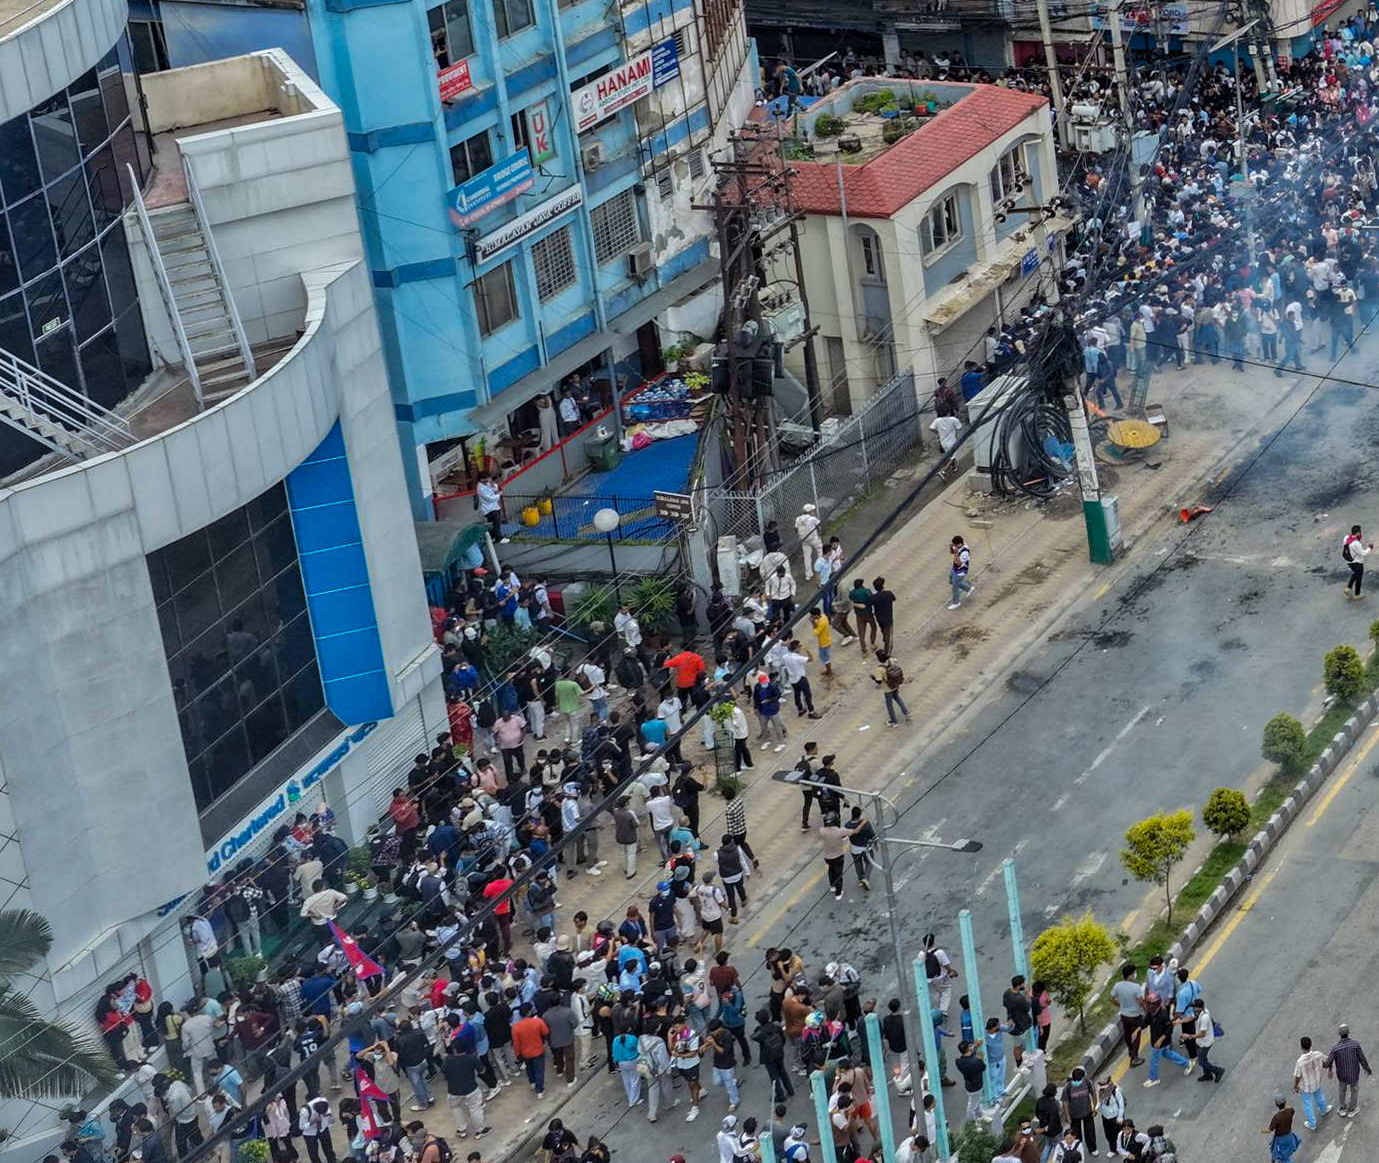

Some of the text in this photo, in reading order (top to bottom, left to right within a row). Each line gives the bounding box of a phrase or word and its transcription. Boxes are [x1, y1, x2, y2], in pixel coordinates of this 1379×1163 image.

[597, 56, 651, 100] HANAMI
[532, 113, 550, 155] UK
[485, 220, 533, 254] HIMALAYAN
[532, 209, 554, 227] JAVA
[220, 794, 286, 861] Chartered
